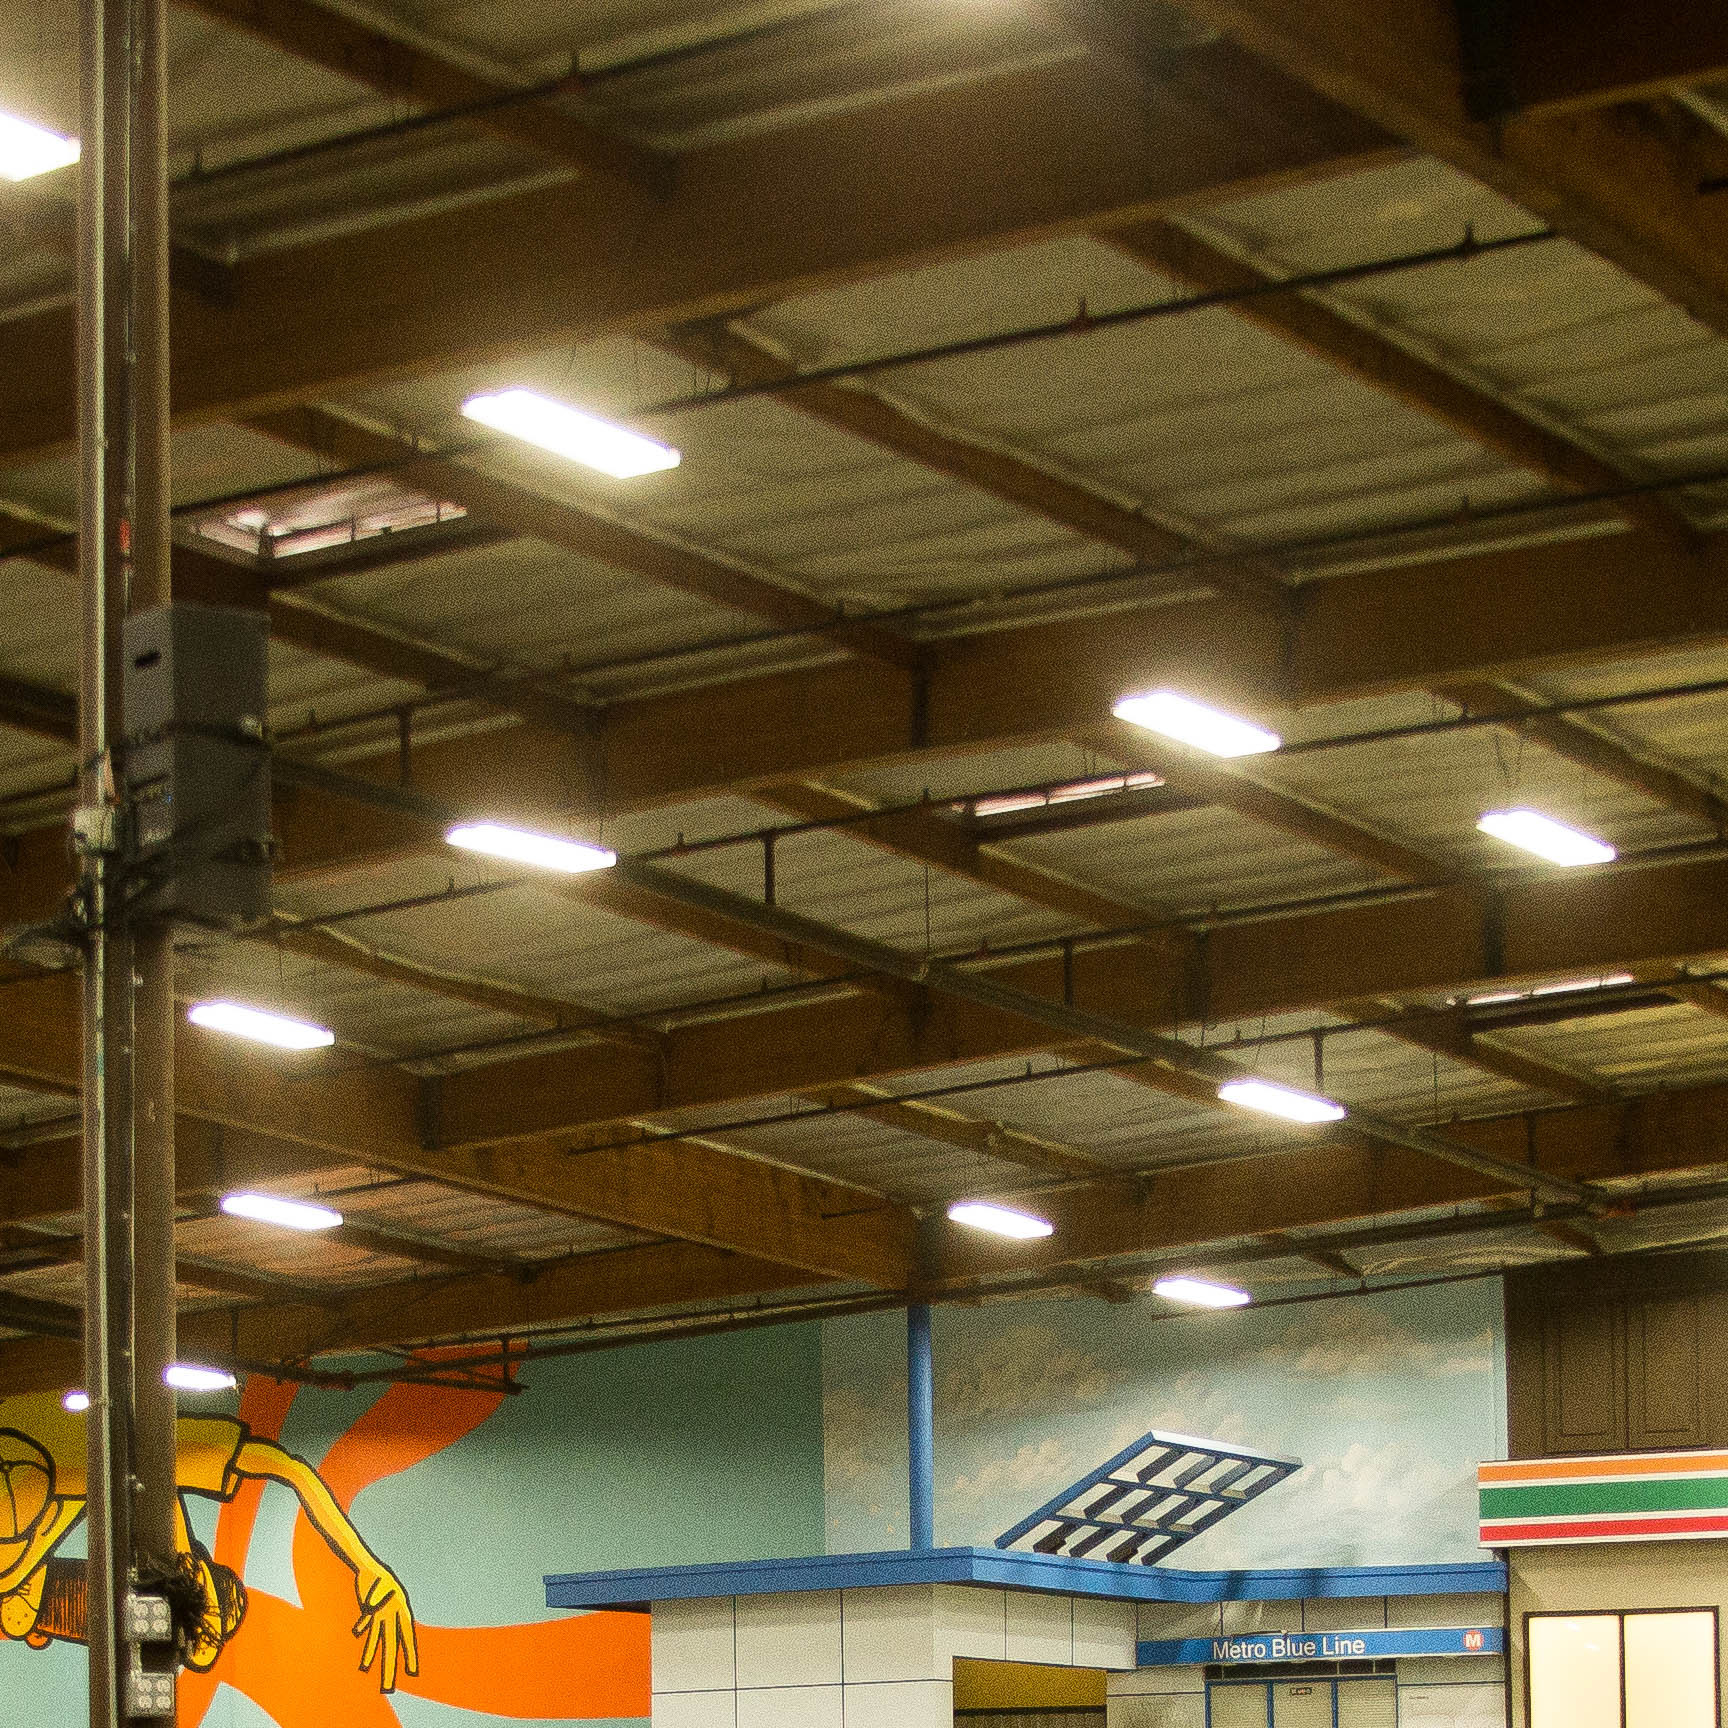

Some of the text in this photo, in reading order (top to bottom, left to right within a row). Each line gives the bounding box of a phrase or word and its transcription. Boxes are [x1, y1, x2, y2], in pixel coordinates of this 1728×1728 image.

[1213, 1635, 1366, 1660] Metro Blue Line
[1464, 1632, 1482, 1648] M
